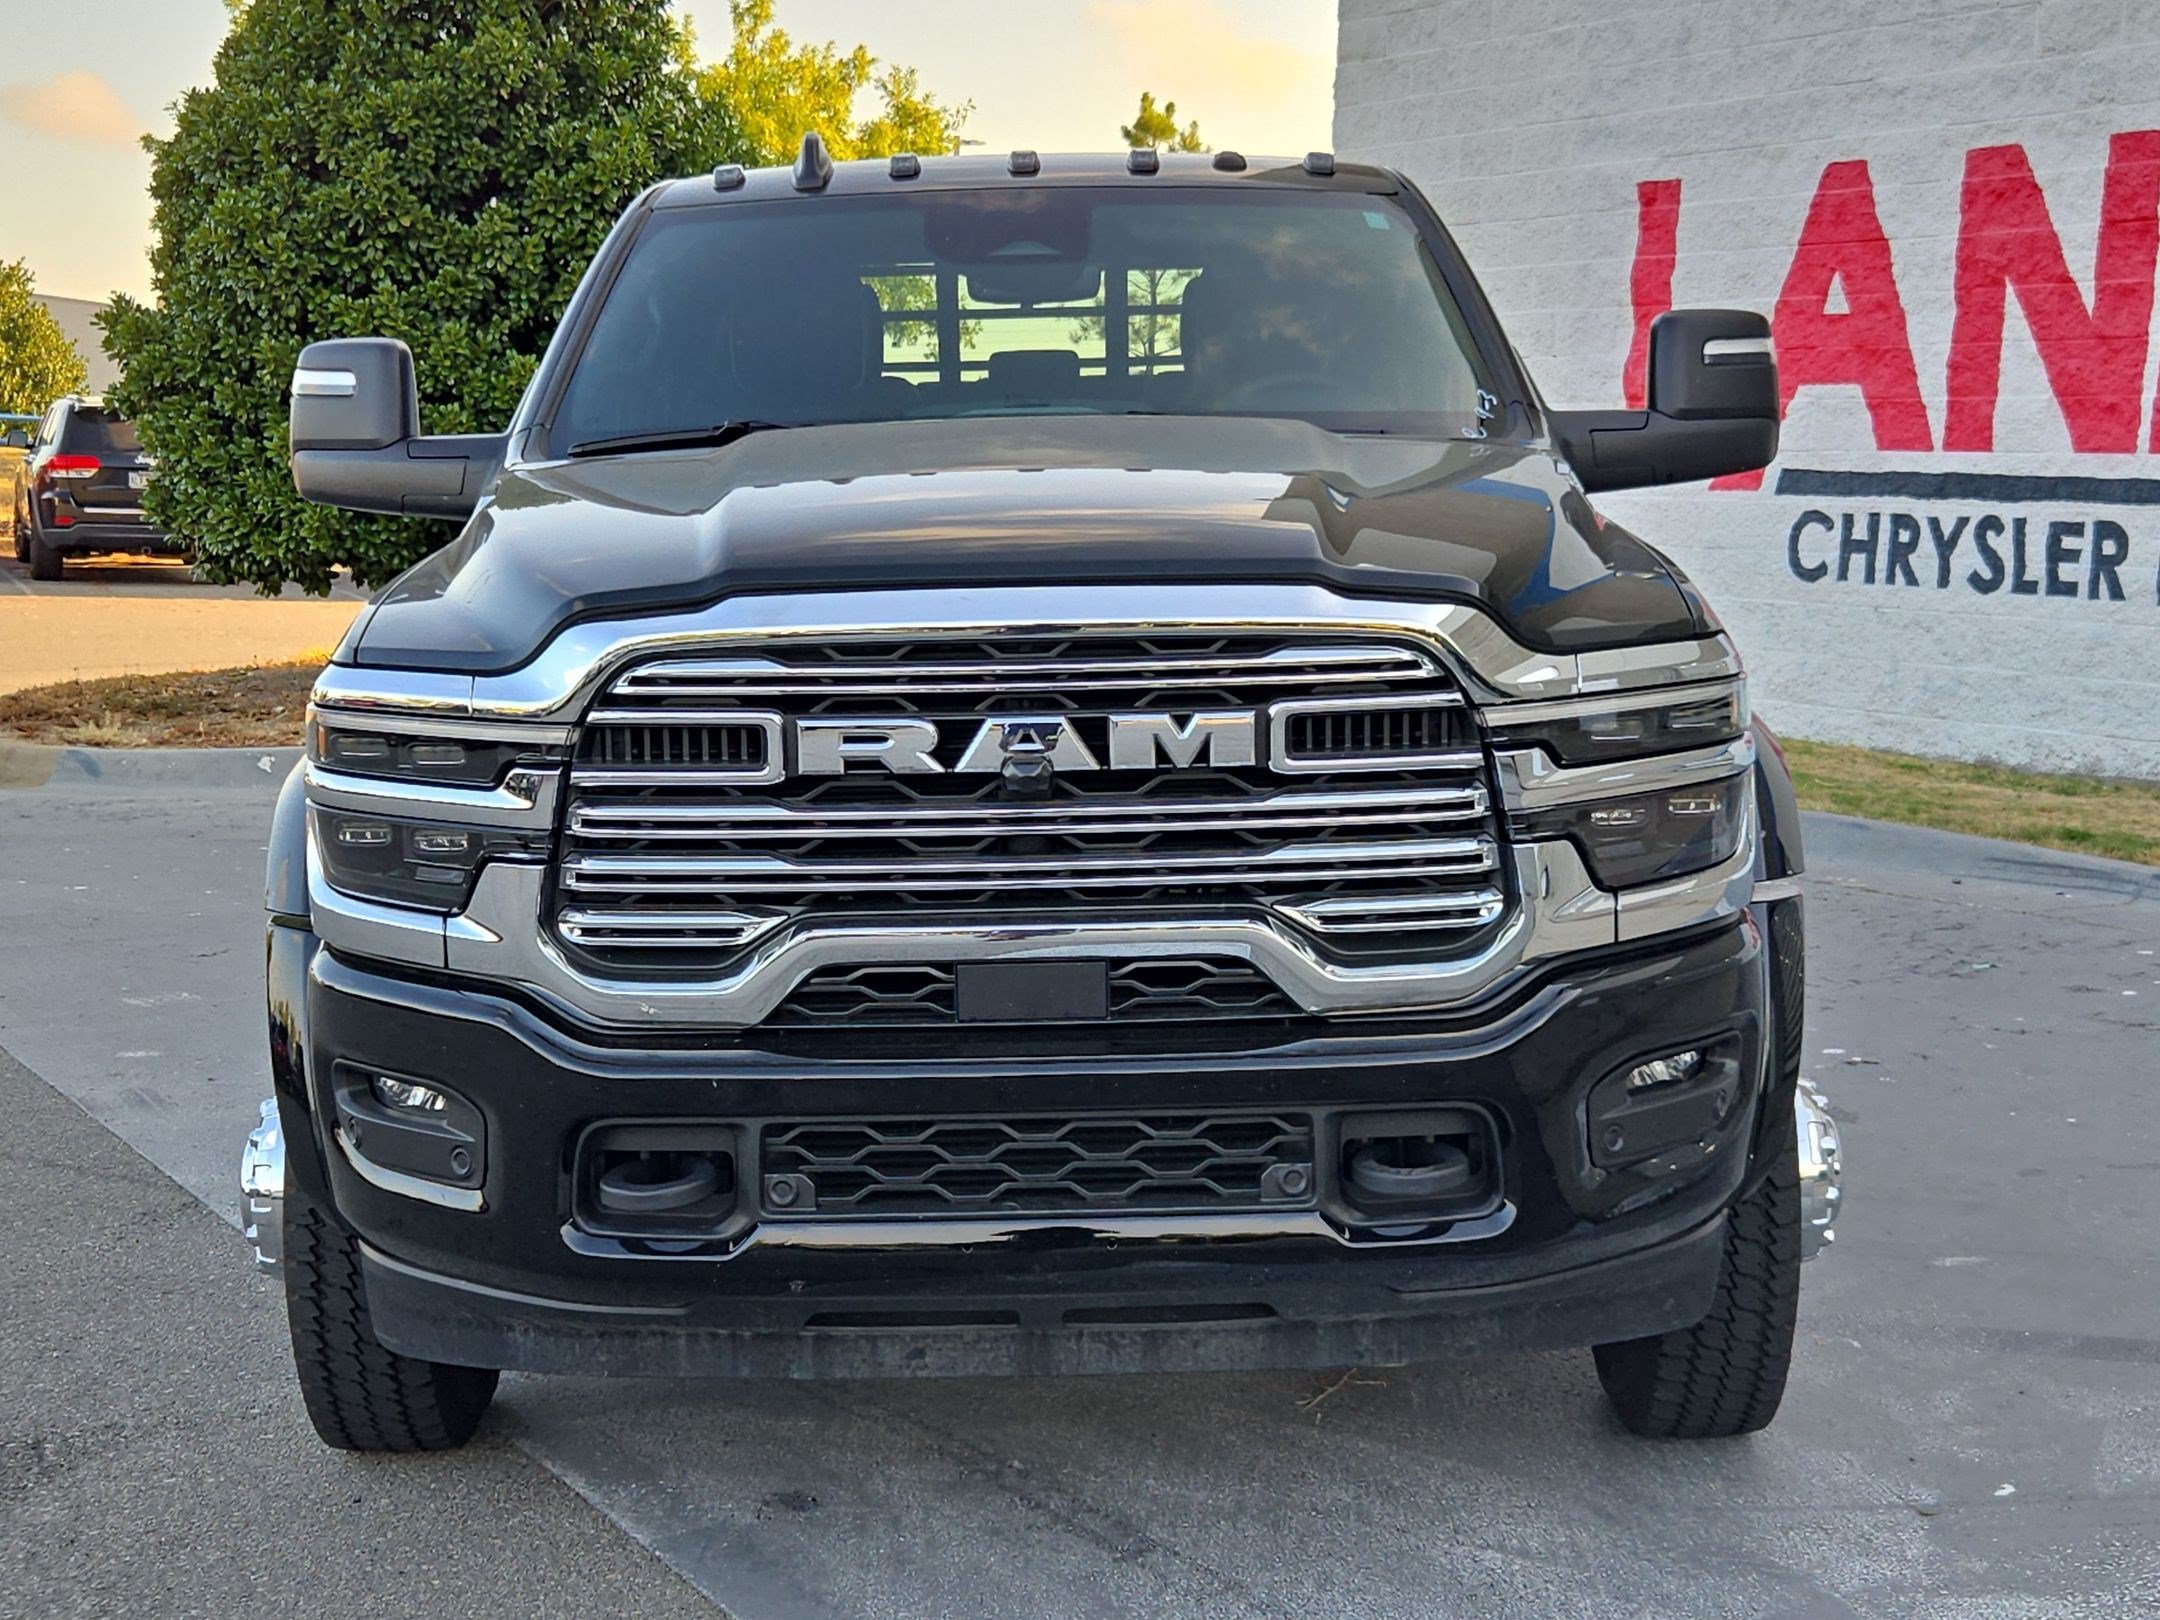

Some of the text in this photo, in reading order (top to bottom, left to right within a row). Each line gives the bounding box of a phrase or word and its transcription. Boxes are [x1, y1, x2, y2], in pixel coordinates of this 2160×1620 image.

[1623, 130, 2160, 491] LAN
[1788, 508, 2129, 601] CHRYSLER
[796, 709, 1256, 775] RAM
